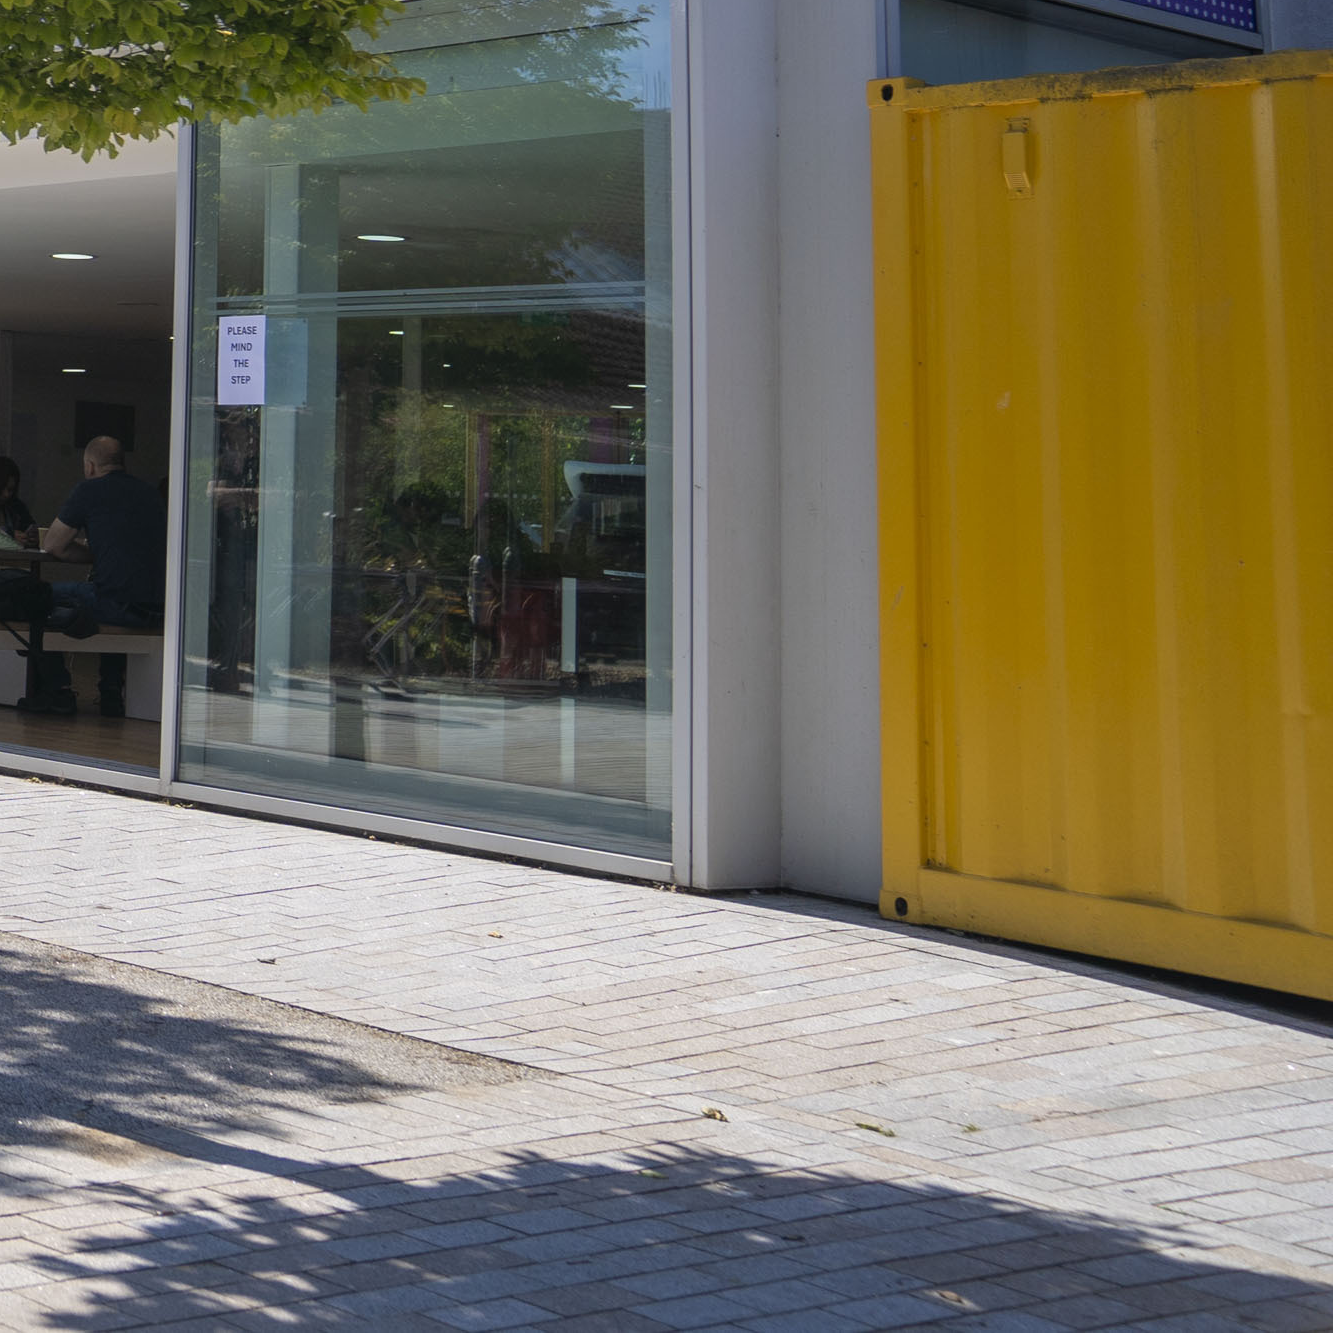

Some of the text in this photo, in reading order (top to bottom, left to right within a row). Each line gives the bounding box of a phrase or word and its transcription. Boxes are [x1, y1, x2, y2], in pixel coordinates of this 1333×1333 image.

[227, 326, 257, 335] PLEASE
[230, 343, 253, 352] MIND
[233, 359, 249, 368] THE
[231, 375, 251, 385] STEP
